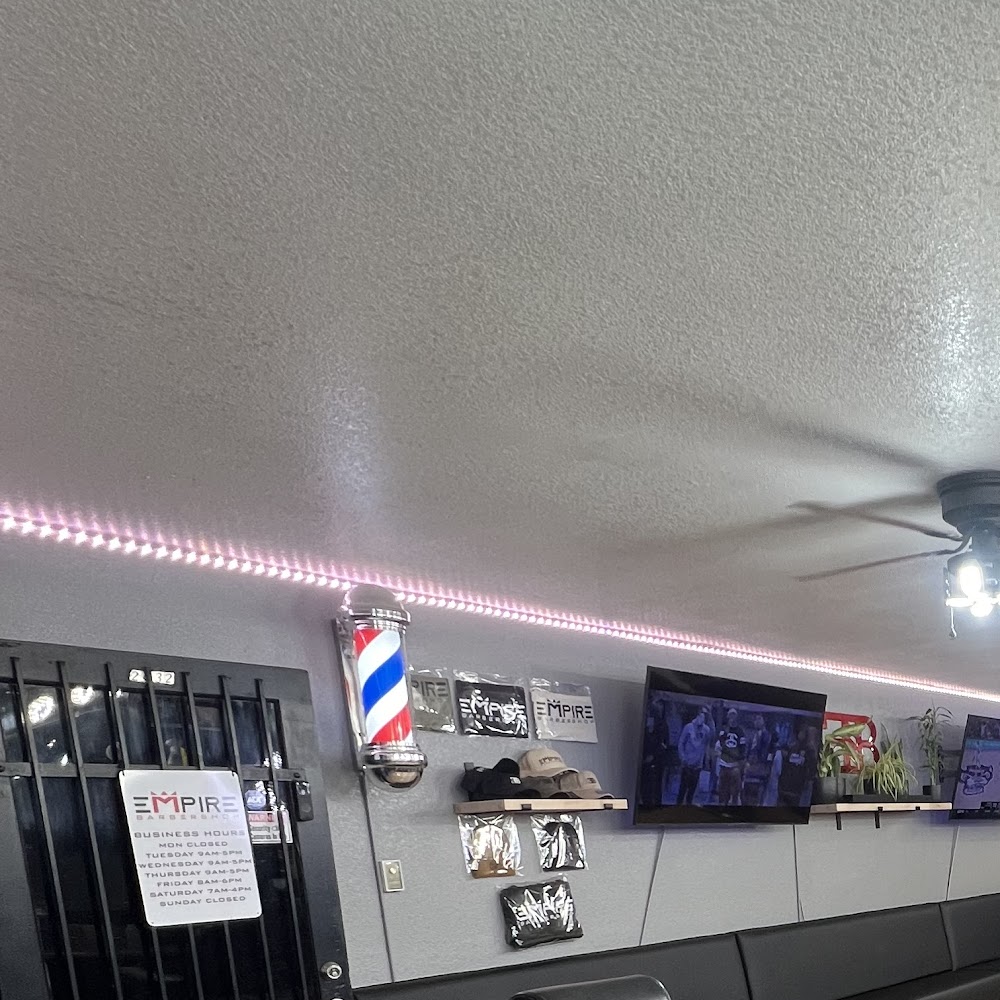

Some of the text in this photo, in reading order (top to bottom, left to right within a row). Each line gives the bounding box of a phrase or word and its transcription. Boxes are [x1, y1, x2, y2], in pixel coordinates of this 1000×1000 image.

[411, 681, 448, 697] PIRE
[536, 698, 593, 719] EMPIRE
[133, 791, 239, 813] EMPIRE
[145, 870, 201, 878] THURSDAY
[150, 889, 204, 897] SATURDAY
[160, 899, 202, 907] SUNDAY
